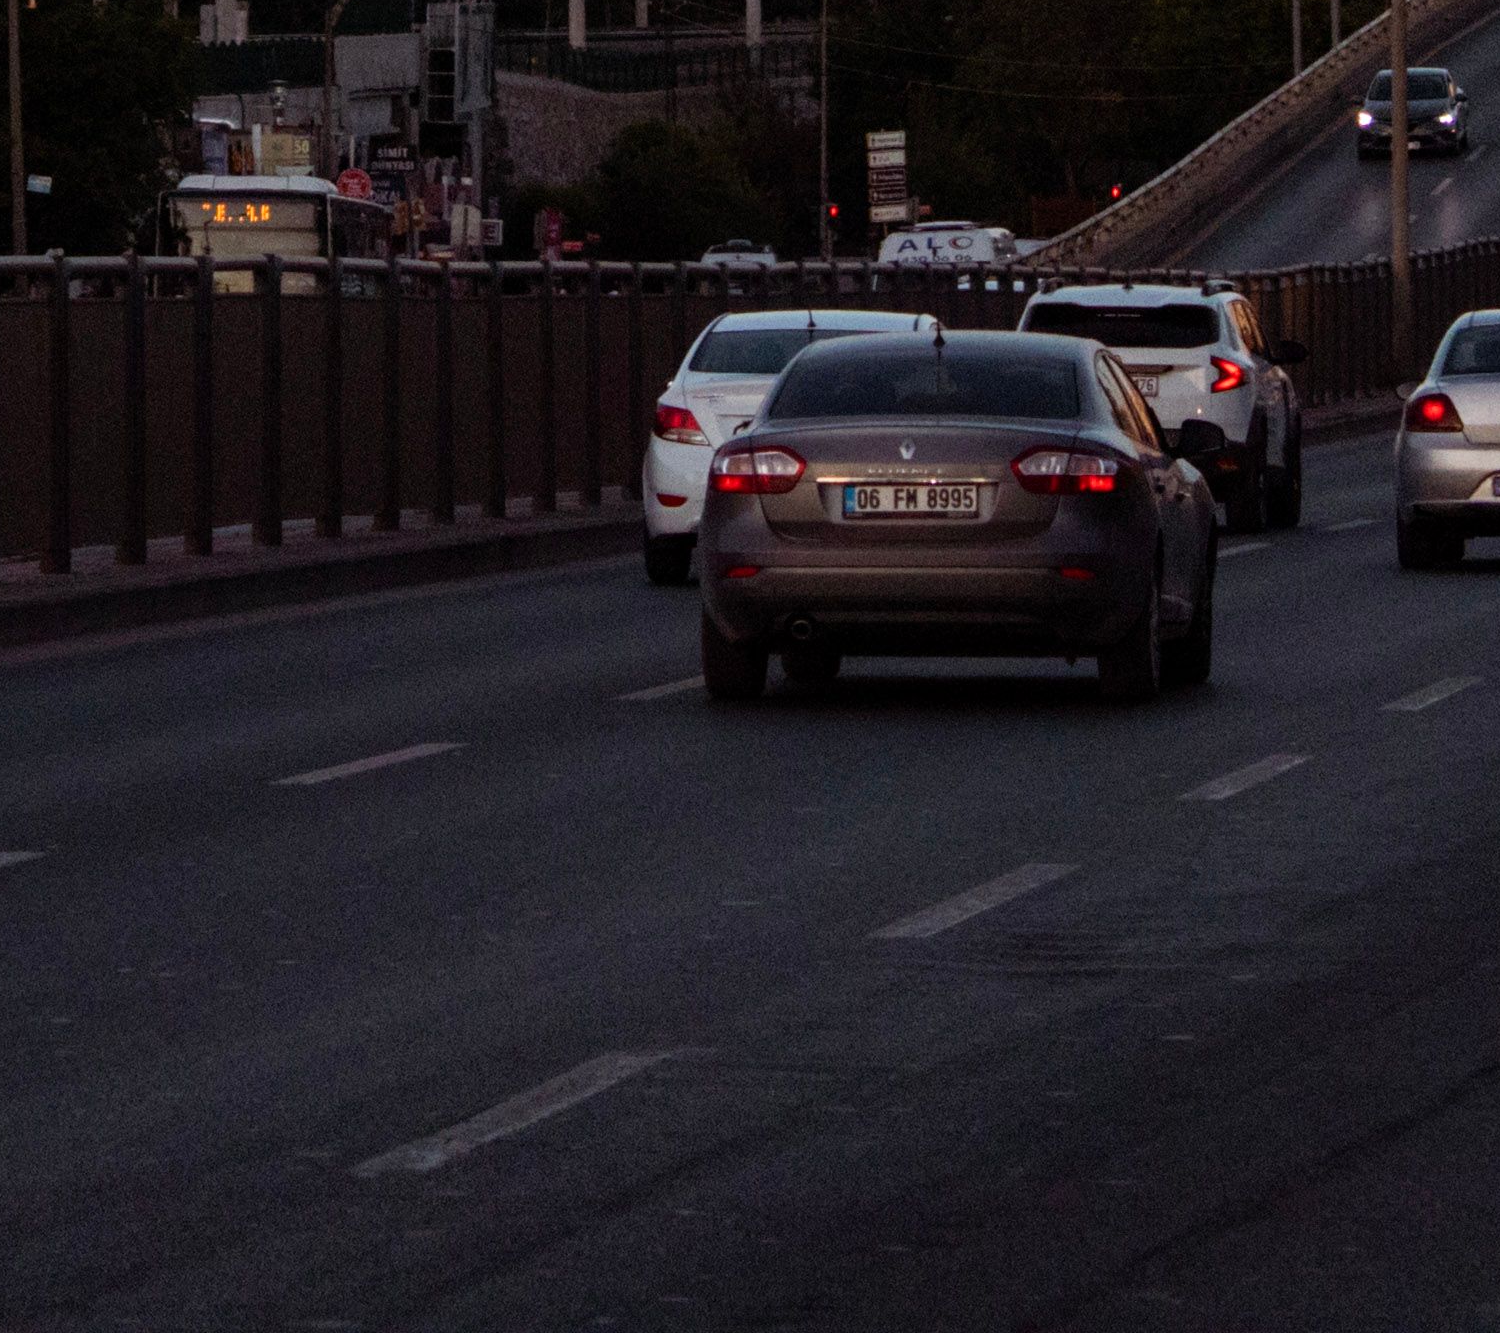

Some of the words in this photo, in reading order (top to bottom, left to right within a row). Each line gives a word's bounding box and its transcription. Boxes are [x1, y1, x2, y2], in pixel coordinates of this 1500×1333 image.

[856, 488, 881, 510] 06
[893, 488, 918, 510] FM
[926, 487, 975, 509] 8995
